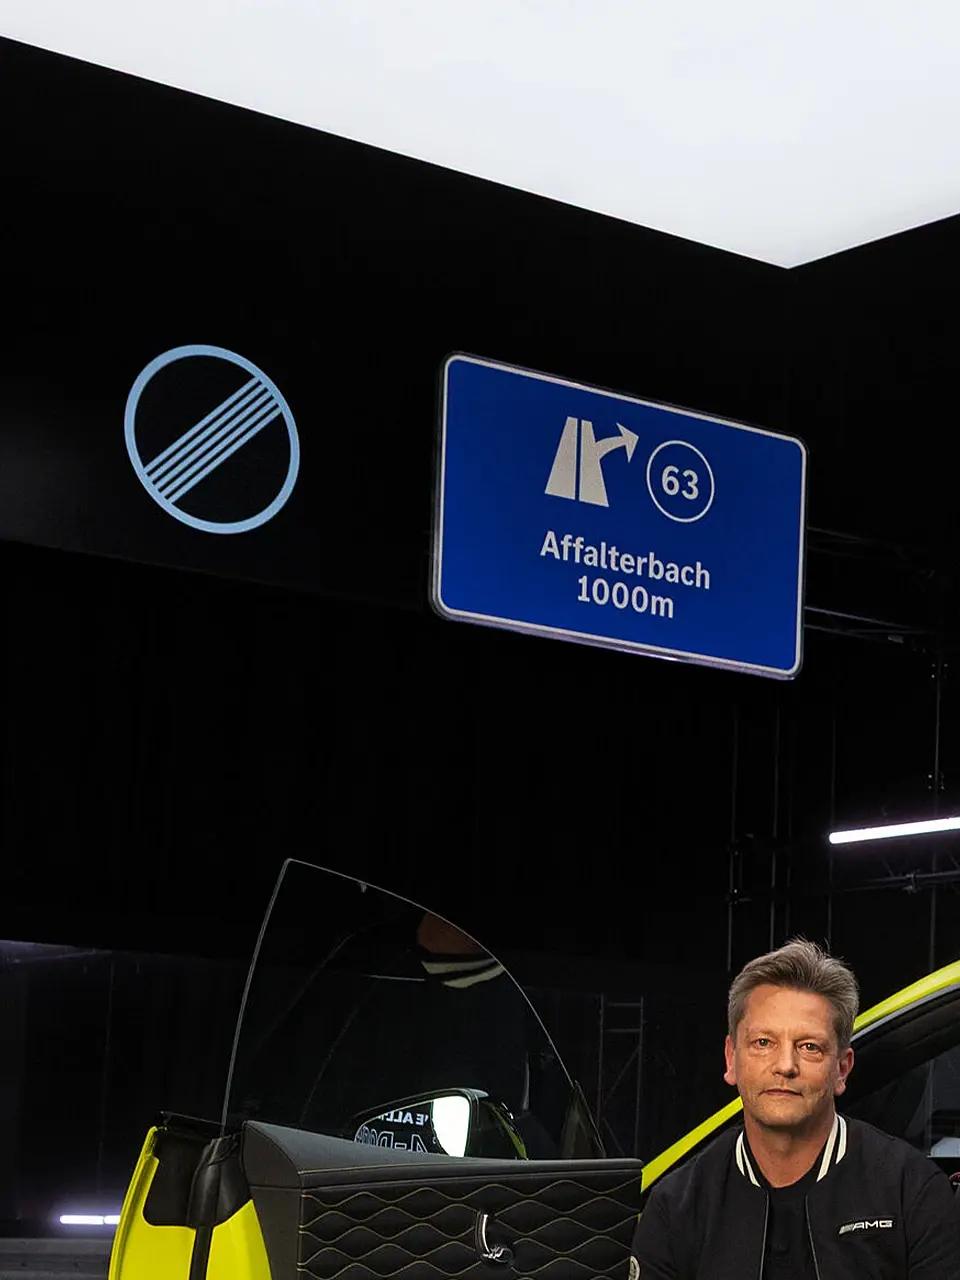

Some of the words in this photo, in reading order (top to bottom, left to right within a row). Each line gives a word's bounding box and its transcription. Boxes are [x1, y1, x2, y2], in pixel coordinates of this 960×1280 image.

[661, 465, 699, 500] 63
[540, 530, 711, 590] Affalterbach
[577, 575, 674, 619] 1000m
